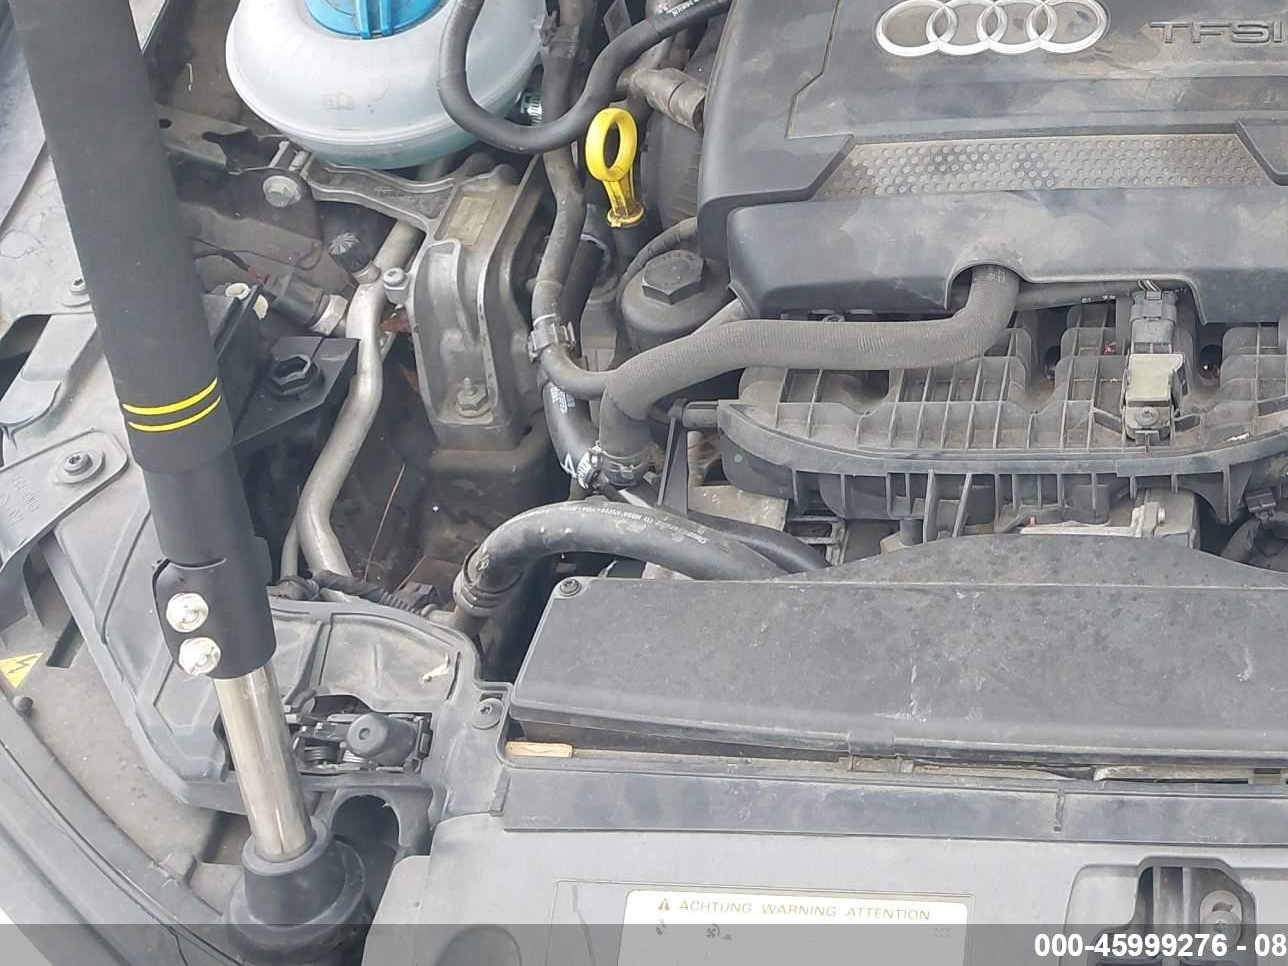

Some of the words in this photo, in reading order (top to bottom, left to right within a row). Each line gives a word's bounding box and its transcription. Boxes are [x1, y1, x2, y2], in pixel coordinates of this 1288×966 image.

[1150, 19, 1283, 45] TFSI
[679, 900, 752, 914] ACHTUNG
[762, 903, 836, 918] WARNING
[847, 906, 930, 921] ATTENTION
